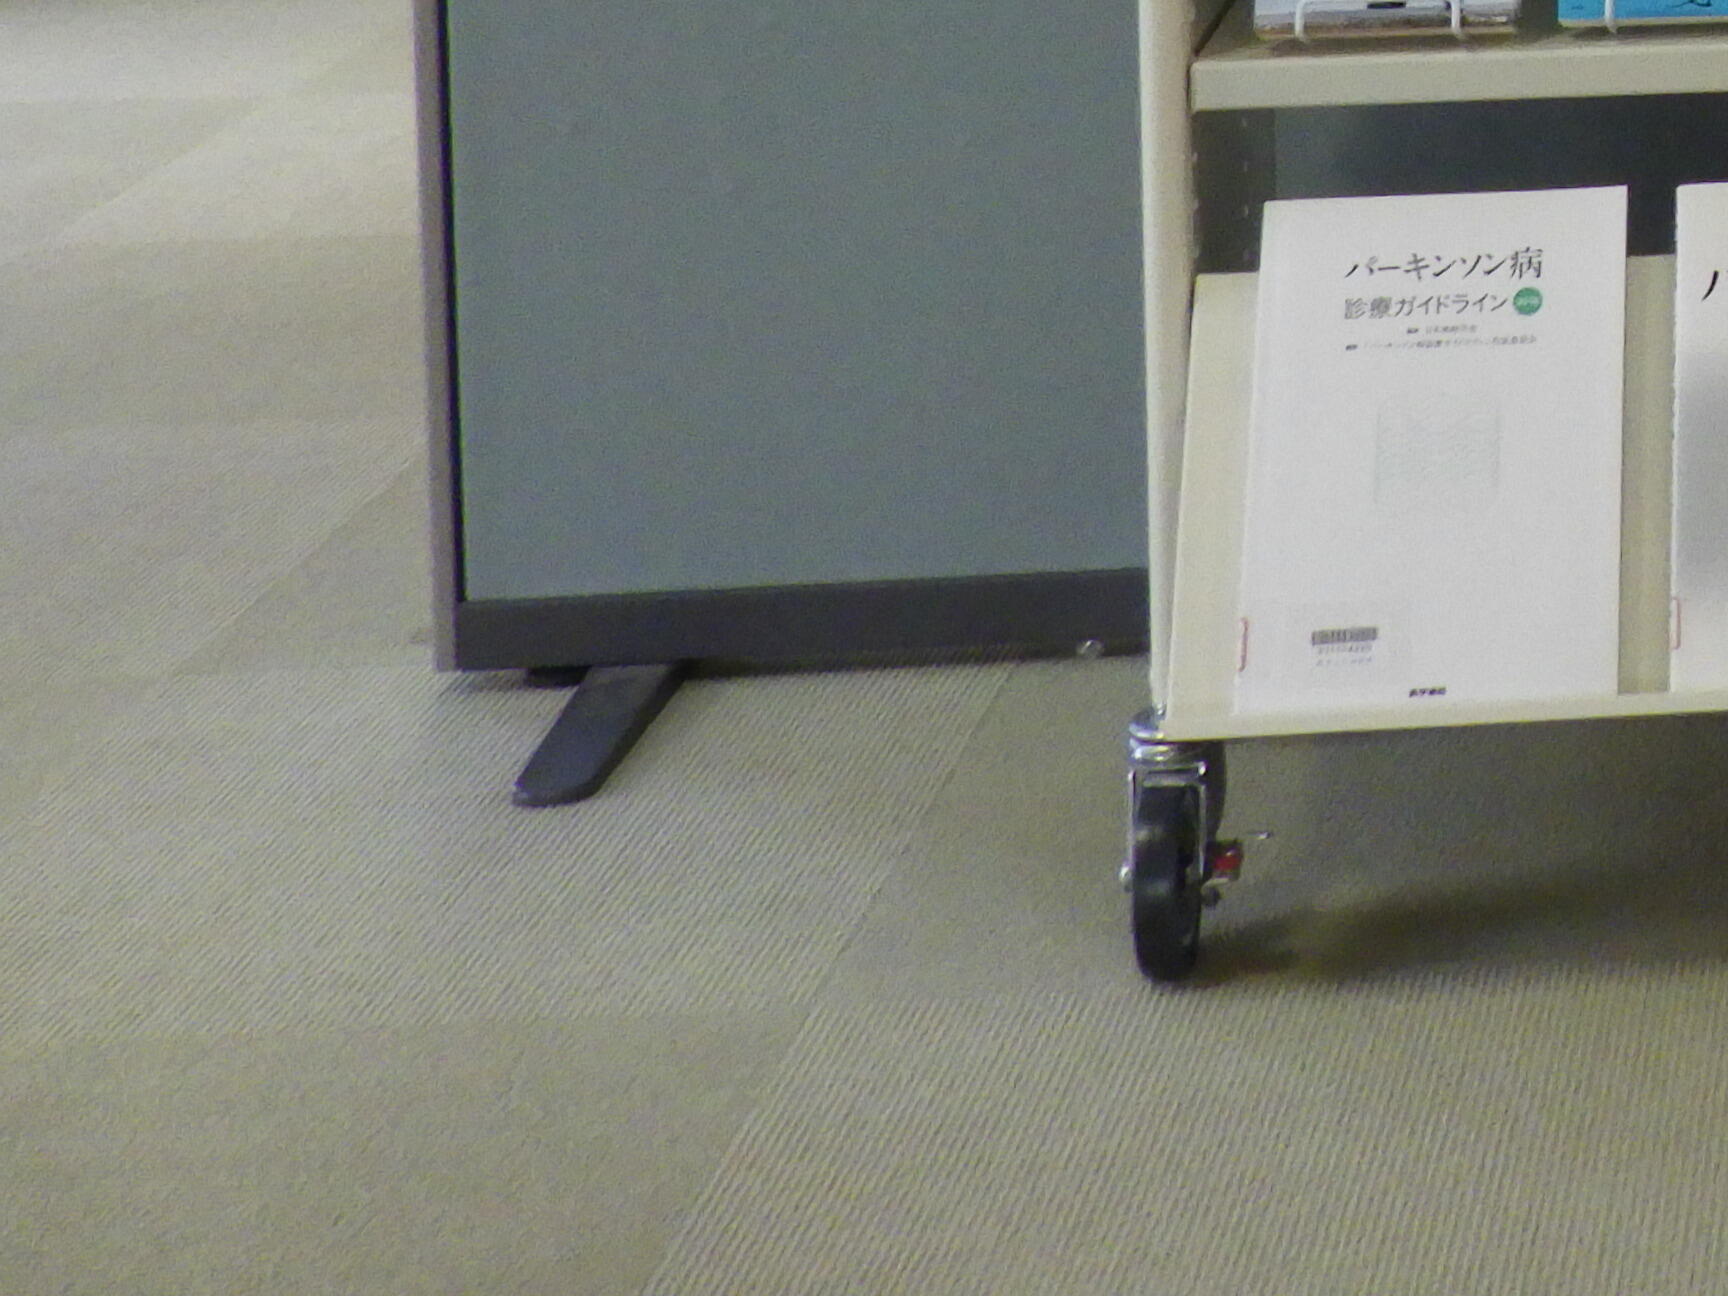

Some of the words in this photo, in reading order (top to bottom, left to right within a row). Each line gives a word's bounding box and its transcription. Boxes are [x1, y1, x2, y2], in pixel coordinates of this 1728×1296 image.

[1344, 246, 1544, 281] パーキンソン病
[1344, 293, 1509, 320] 診療ガイドライン
